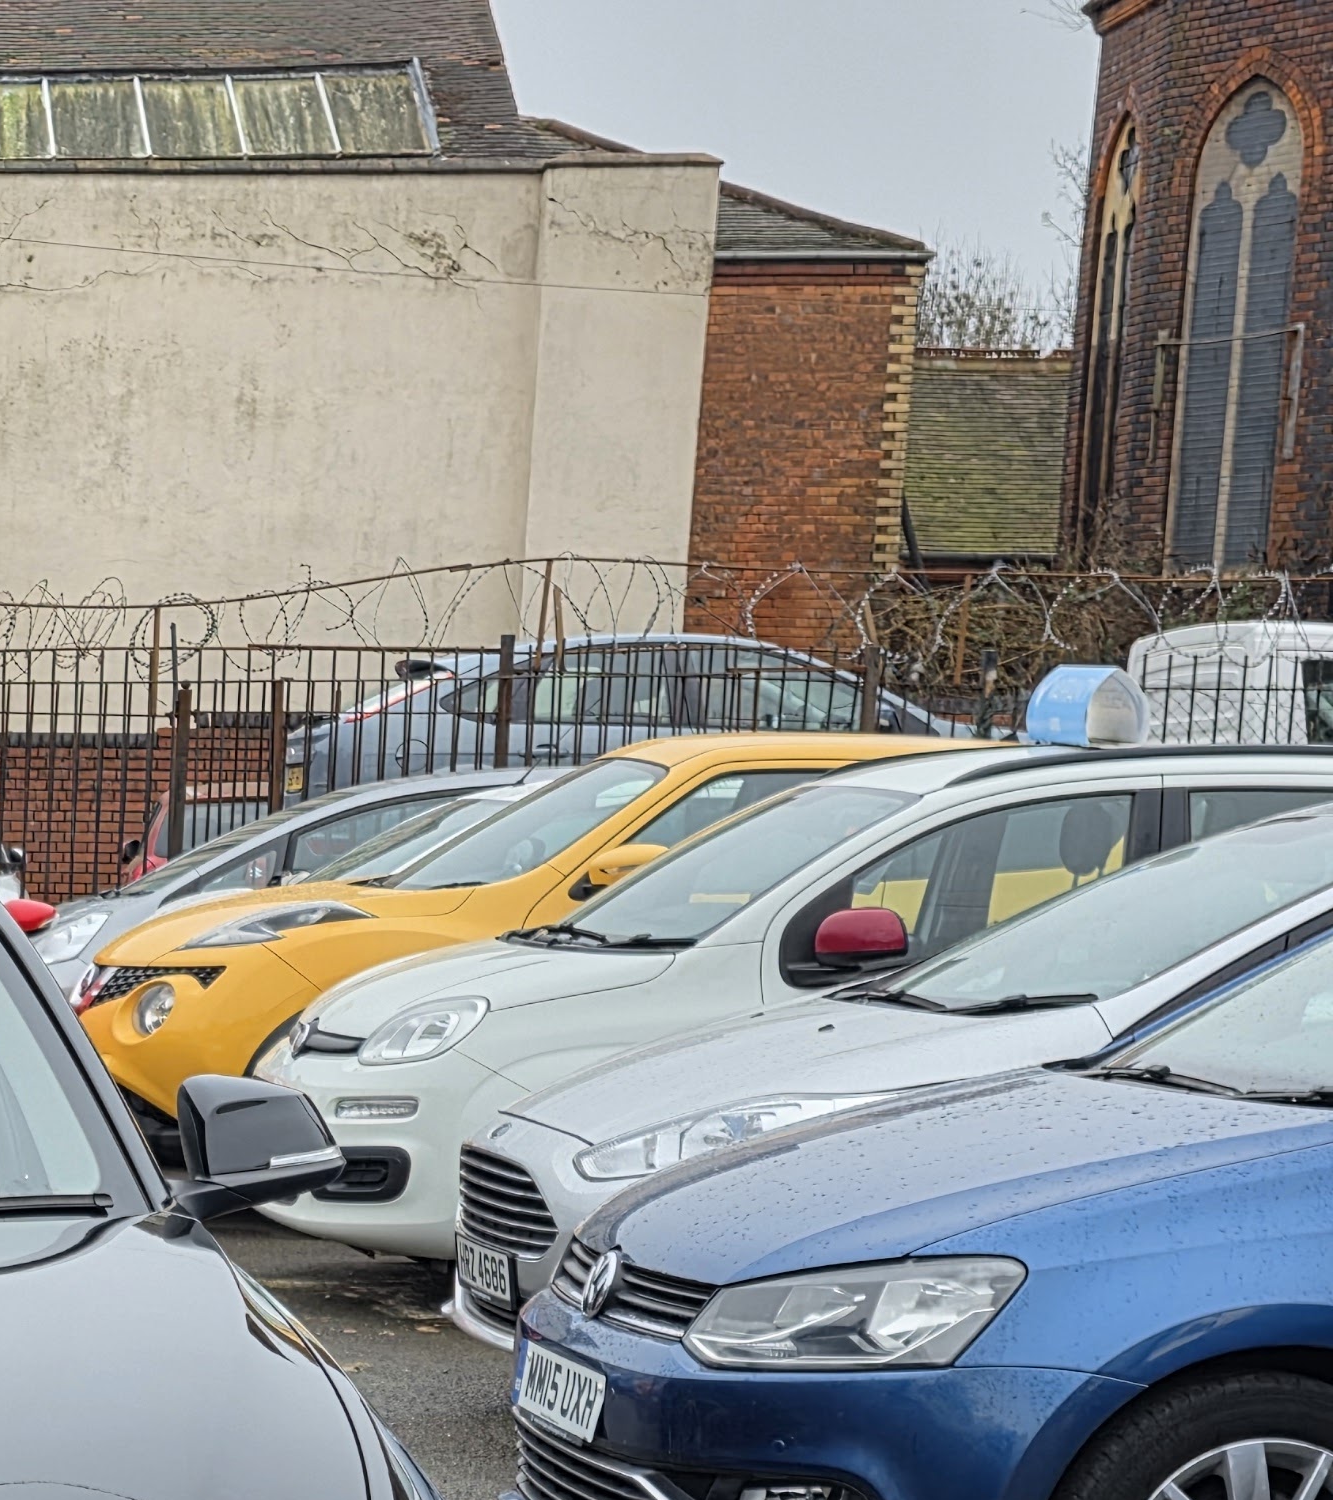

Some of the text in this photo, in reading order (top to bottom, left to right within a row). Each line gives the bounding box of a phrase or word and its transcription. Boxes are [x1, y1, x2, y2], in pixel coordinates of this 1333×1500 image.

[478, 1251, 507, 1295] 4686
[525, 1351, 598, 1430] MM15 UXH
